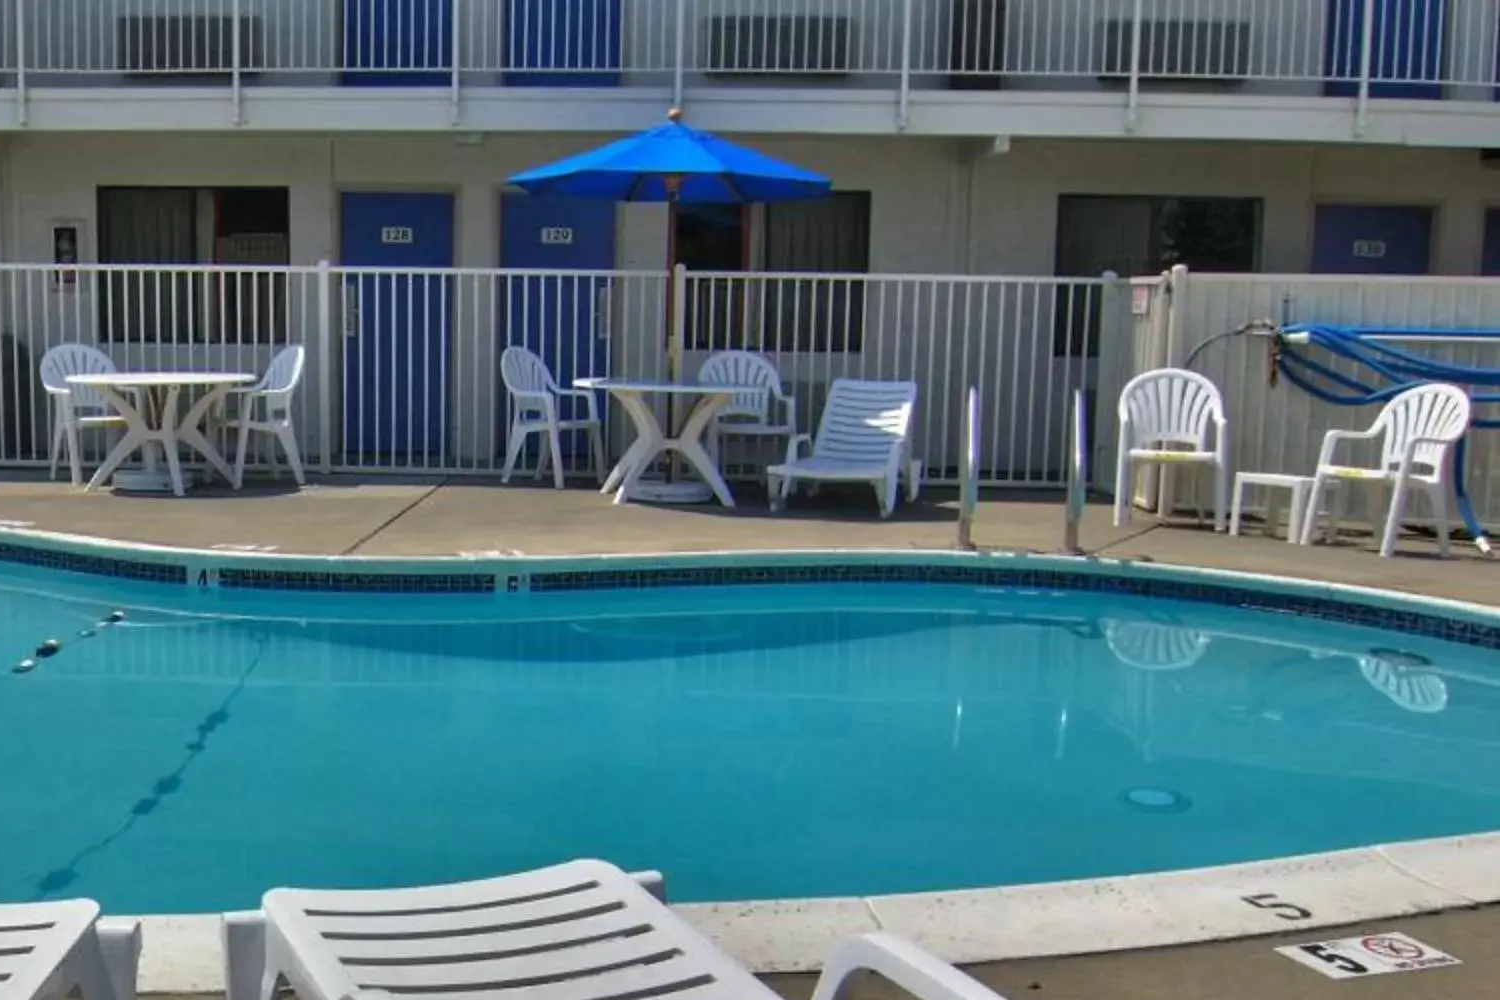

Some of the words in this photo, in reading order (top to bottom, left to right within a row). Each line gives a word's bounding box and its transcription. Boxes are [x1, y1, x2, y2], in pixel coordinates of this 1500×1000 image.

[384, 228, 410, 242] 128
[1241, 893, 1312, 920] 5
[1299, 944, 1368, 973] 5
